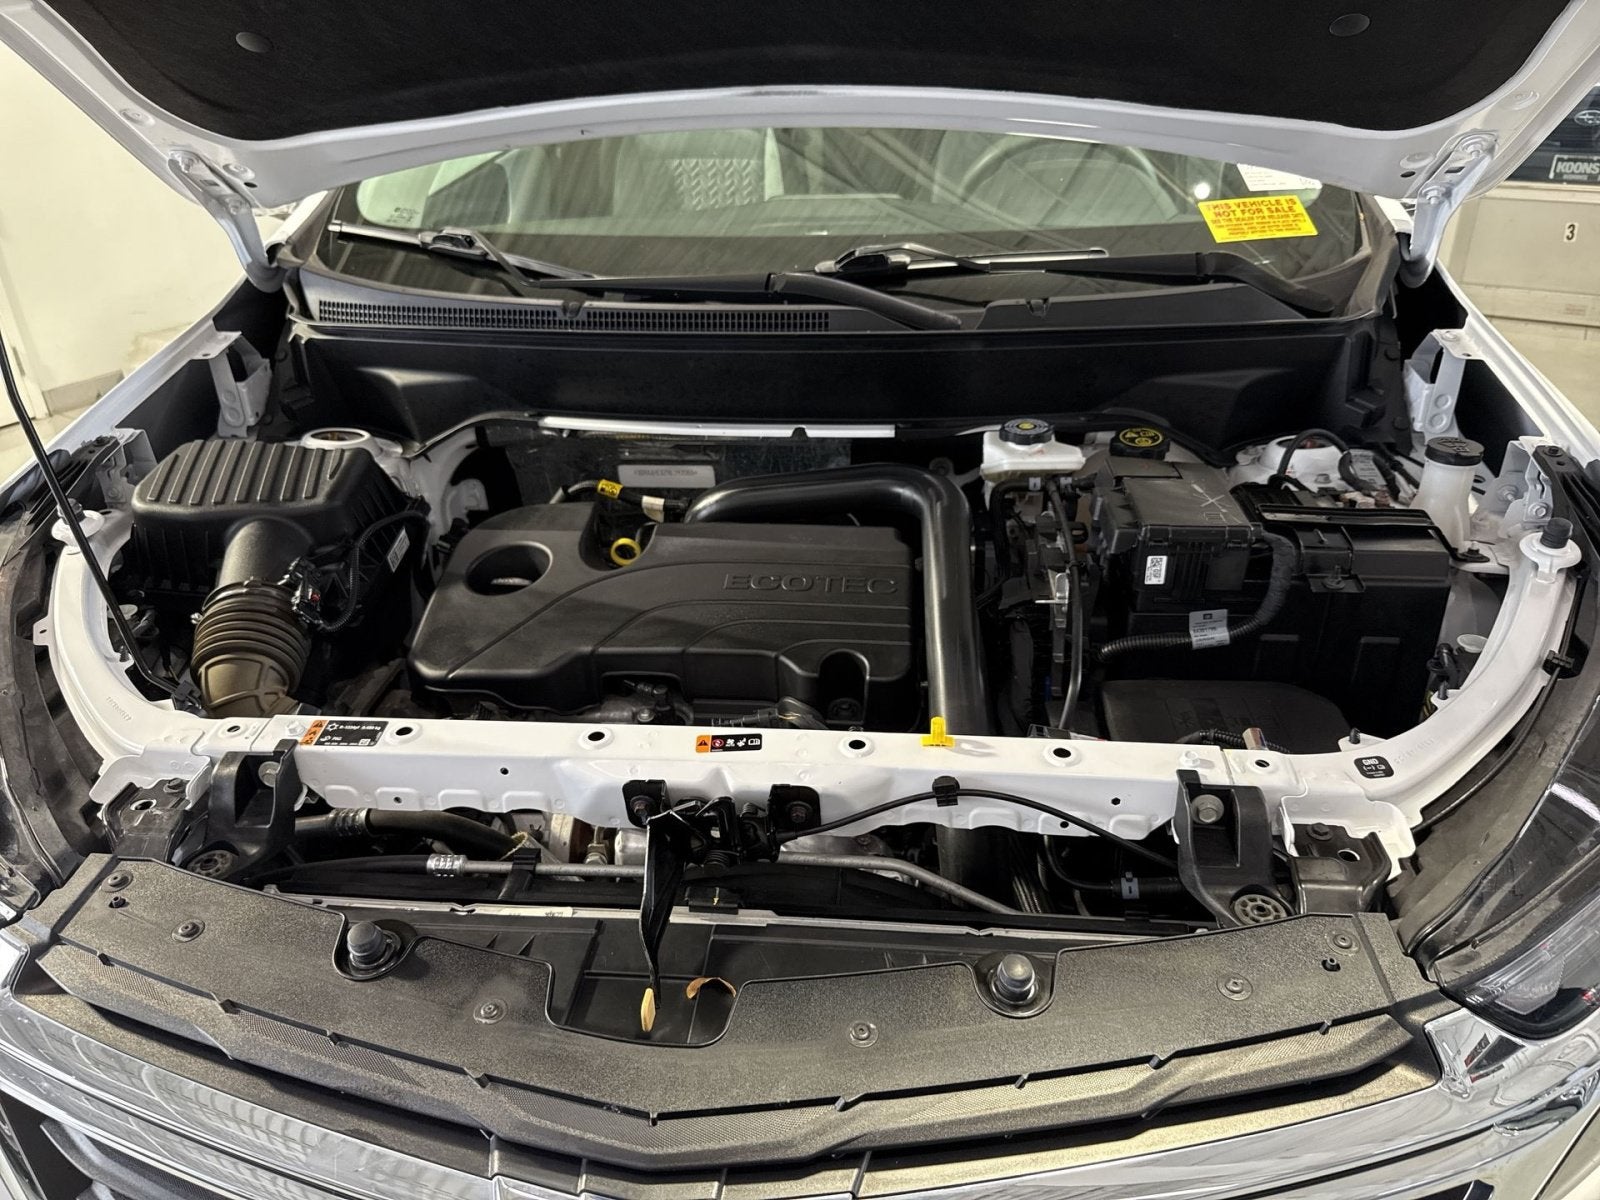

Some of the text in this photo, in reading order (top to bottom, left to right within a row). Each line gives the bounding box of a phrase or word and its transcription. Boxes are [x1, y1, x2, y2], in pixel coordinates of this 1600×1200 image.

[1556, 161, 1600, 174] KOONS
[1206, 198, 1297, 211] THIS VEHICLE IS
[1214, 205, 1296, 218] NOT FOR SALE
[1565, 223, 1576, 241] 3
[723, 573, 898, 595] ECOTEC
